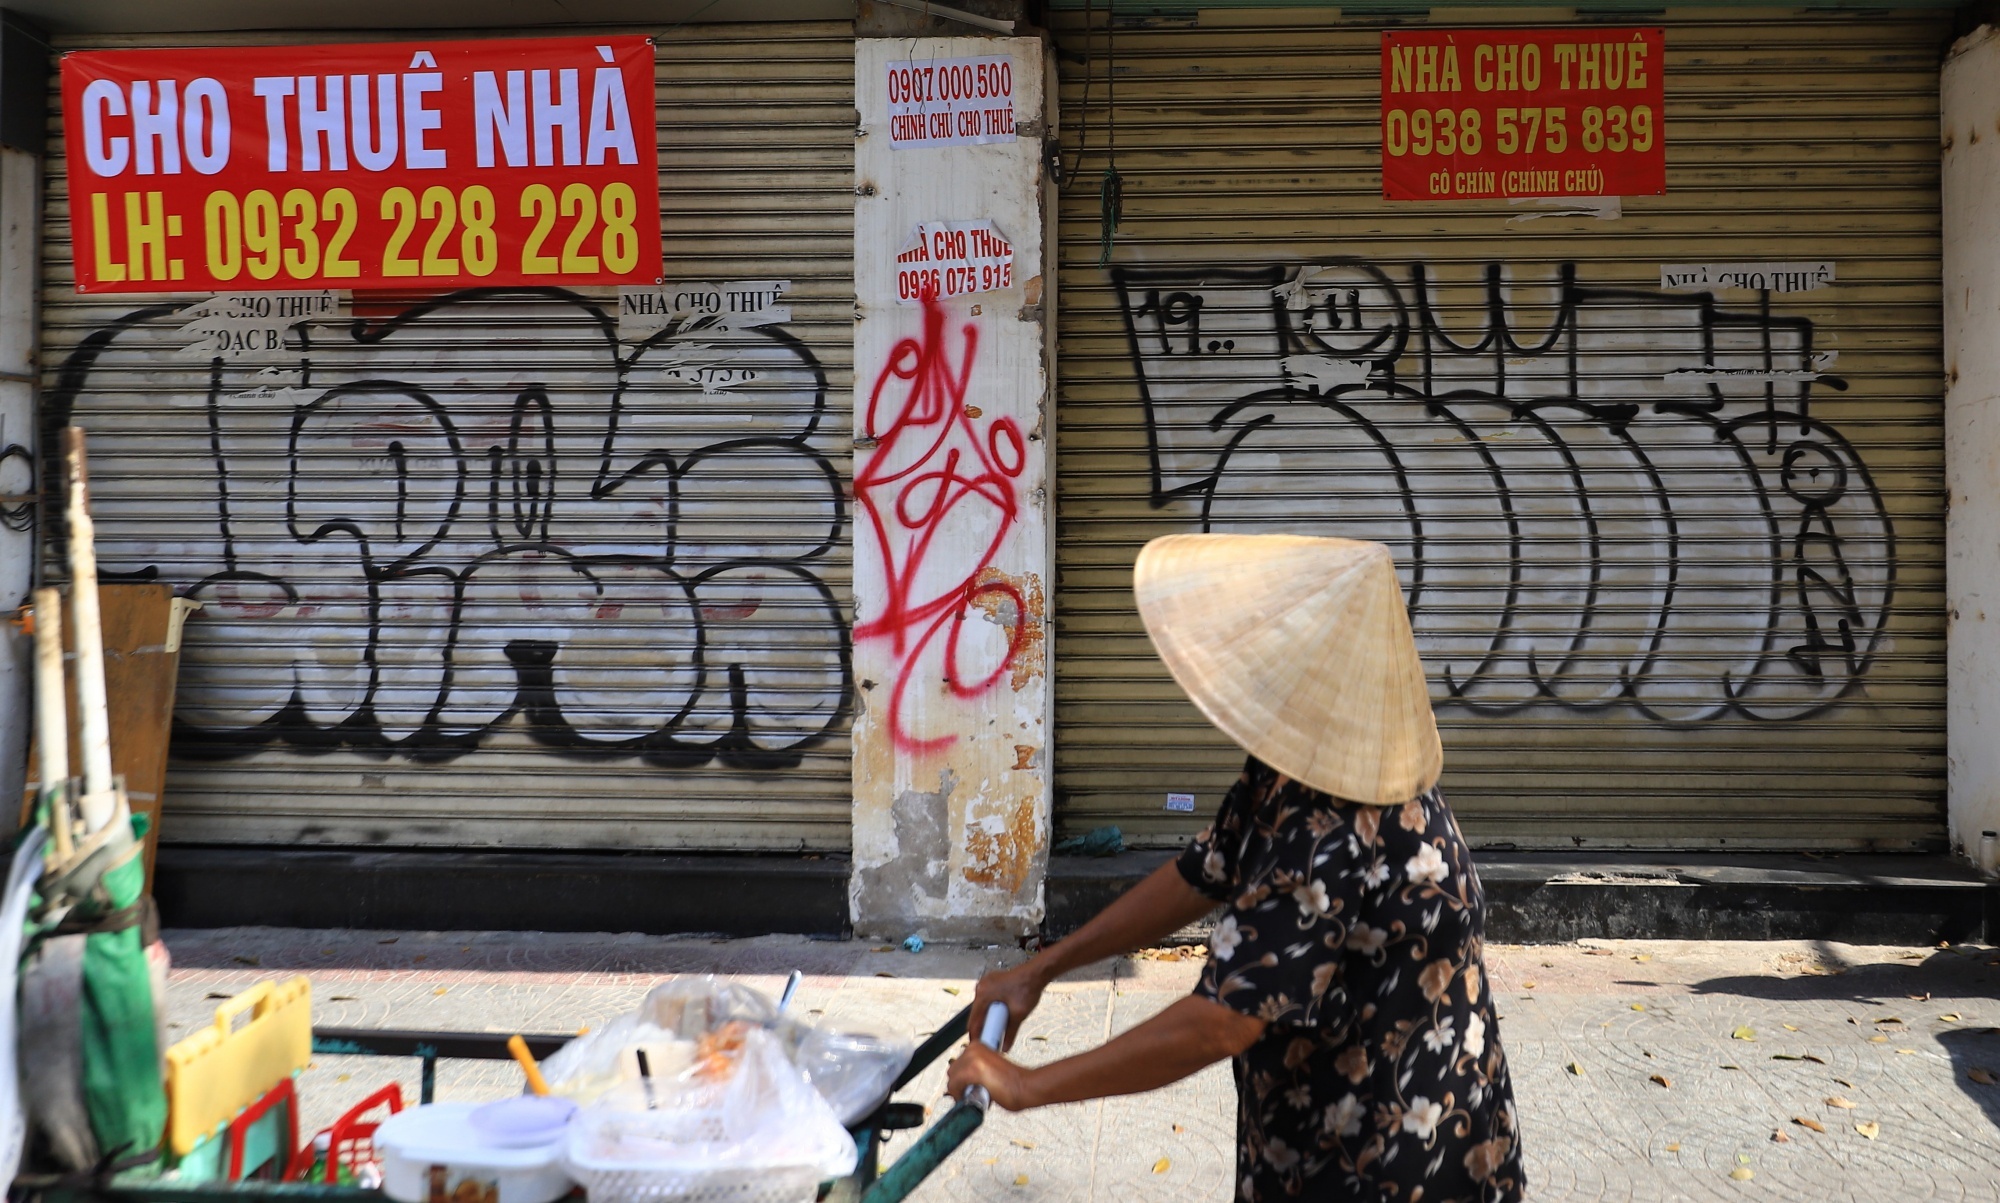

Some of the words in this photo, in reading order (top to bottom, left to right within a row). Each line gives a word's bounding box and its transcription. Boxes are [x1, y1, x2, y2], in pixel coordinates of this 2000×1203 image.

[888, 62, 1012, 104] 0907.000.500
[1390, 34, 1463, 93] NHÀ
[1474, 43, 1541, 92] CHO
[1553, 32, 1649, 90] THUÊ
[82, 77, 232, 178] CHO
[253, 51, 447, 173] THUÊ
[472, 45, 640, 169] NHÀ
[891, 107, 927, 142] CHÍNH
[930, 102, 953, 139] CHỦ
[958, 109, 981, 137] CHO
[984, 100, 1015, 136] THUÊ
[1386, 108, 1482, 157] 0938
[1496, 107, 1568, 154] 575
[1581, 105, 1654, 153] 839
[1429, 168, 1450, 195] CÔ
[1455, 167, 1496, 194] CHÍN
[1501, 166, 1560, 196] (CHÍNH
[1564, 164, 1605, 195] CHỦ)
[92, 191, 185, 281] LH:
[204, 187, 361, 280] 0932
[380, 185, 499, 277] 228
[519, 183, 640, 275] 228
[933, 230, 967, 261] CHO
[899, 268, 941, 299] 0936
[946, 267, 977, 295] 075
[982, 262, 1012, 293] 915
